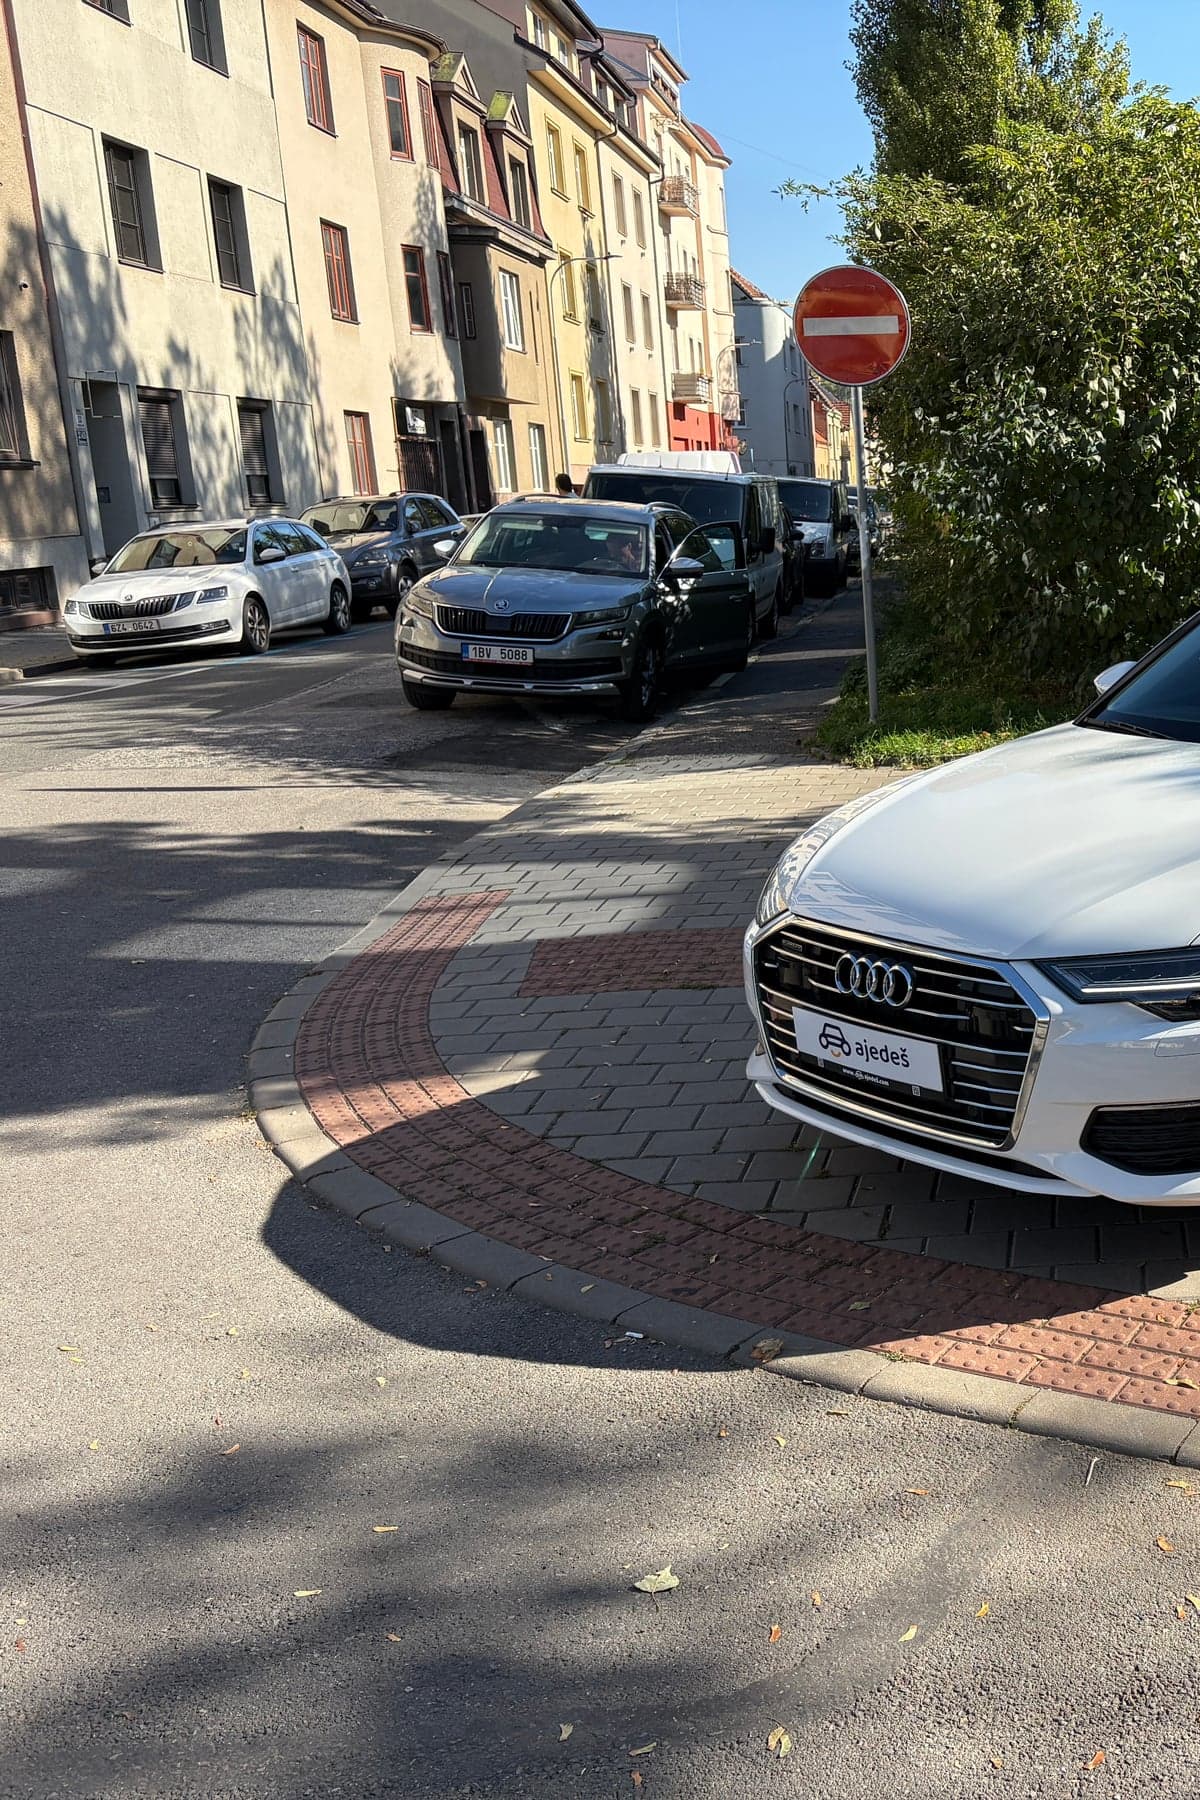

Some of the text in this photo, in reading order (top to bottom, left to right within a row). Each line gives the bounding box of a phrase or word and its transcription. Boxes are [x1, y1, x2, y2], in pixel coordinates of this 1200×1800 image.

[110, 621, 154, 633] 6Z4 0642
[472, 646, 528, 661] 1BV 5088
[855, 1038, 910, 1068] ajedeš
